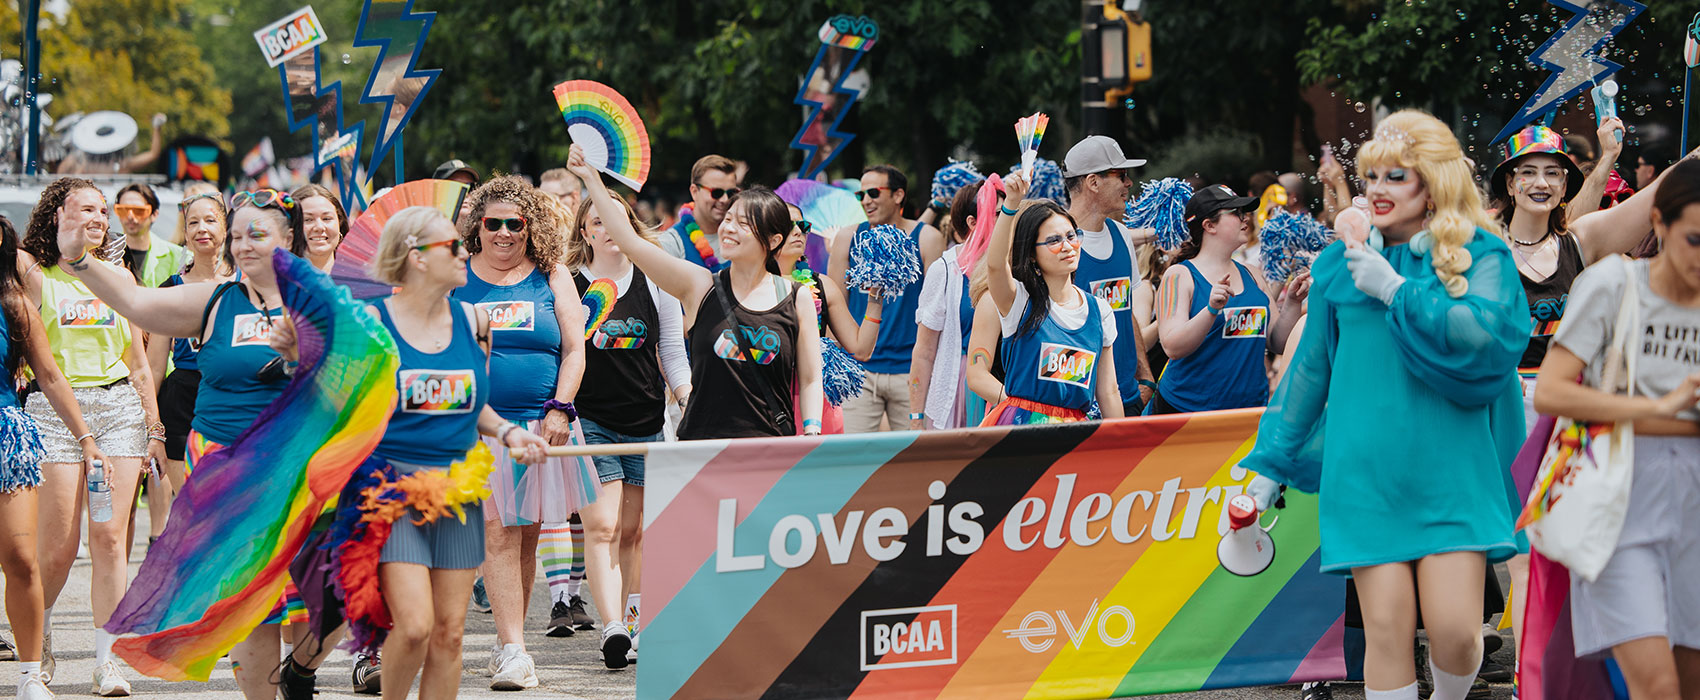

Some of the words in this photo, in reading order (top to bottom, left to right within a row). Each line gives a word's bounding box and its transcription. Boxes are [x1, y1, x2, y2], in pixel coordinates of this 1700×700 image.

[264, 18, 317, 57] BCAA
[832, 18, 876, 38] evo
[599, 100, 624, 125] evo
[65, 303, 110, 320] BCAA
[1530, 298, 1567, 320] ev
[601, 321, 645, 336] evo
[1231, 313, 1262, 332] BCAA
[1645, 324, 1654, 336] A
[1047, 352, 1086, 378] BCAA
[412, 379, 467, 404] BCAA
[716, 498, 908, 573] Love
[926, 480, 985, 557] is
[1003, 463, 1279, 552] electri
[874, 620, 945, 656] BCAA
[1002, 598, 1136, 654] evo
